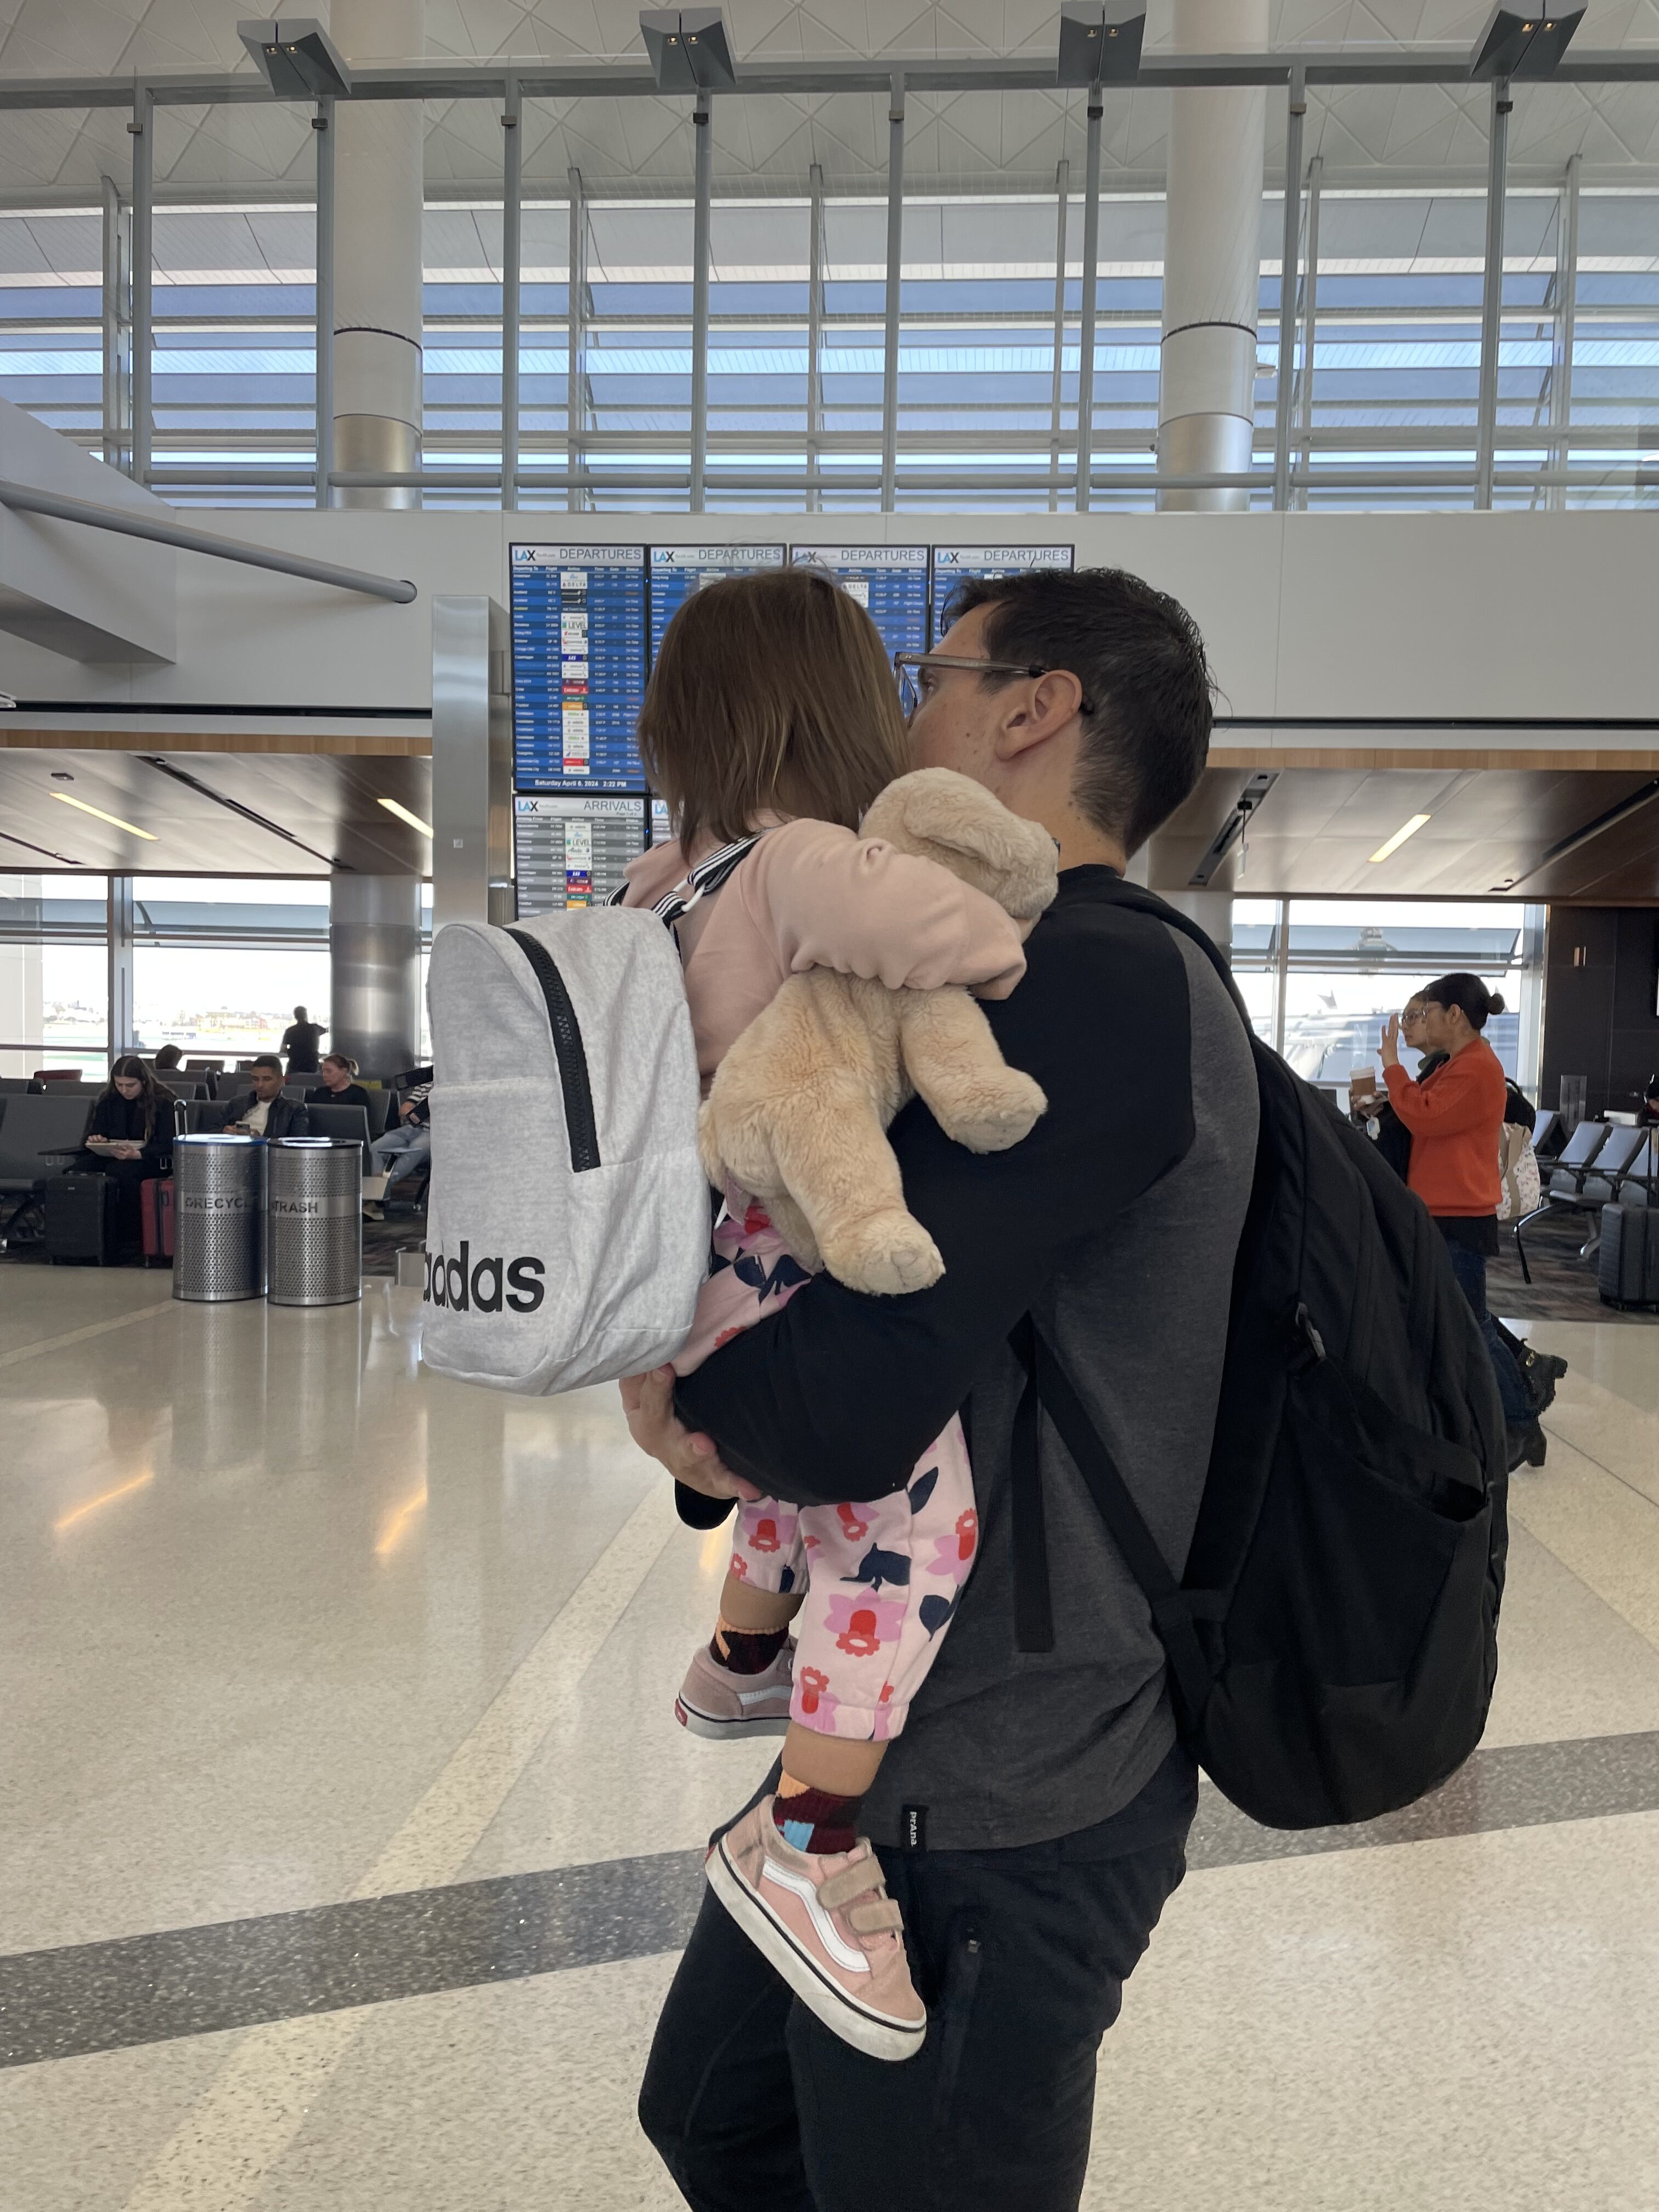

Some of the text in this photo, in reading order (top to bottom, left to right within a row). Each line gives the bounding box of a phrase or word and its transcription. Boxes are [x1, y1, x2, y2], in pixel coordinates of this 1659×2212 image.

[515, 550, 535, 561] LAX
[560, 549, 641, 560] DEPARTURES
[653, 551, 674, 562] LAX
[698, 549, 781, 560] DEPARTURES
[841, 550, 924, 561] DEPARTURES
[938, 552, 959, 563] LAX
[984, 550, 1069, 561] DEPARTURES
[568, 621, 587, 629] LEVEL
[535, 780, 561, 788] Saturday
[518, 801, 538, 811] LAX
[584, 800, 641, 811] ARRIVALS
[654, 804, 667, 814] LA
[194, 1198, 251, 1209] RECYCL
[274, 1200, 318, 1214] TRASH
[423, 1240, 545, 1313] ddas
